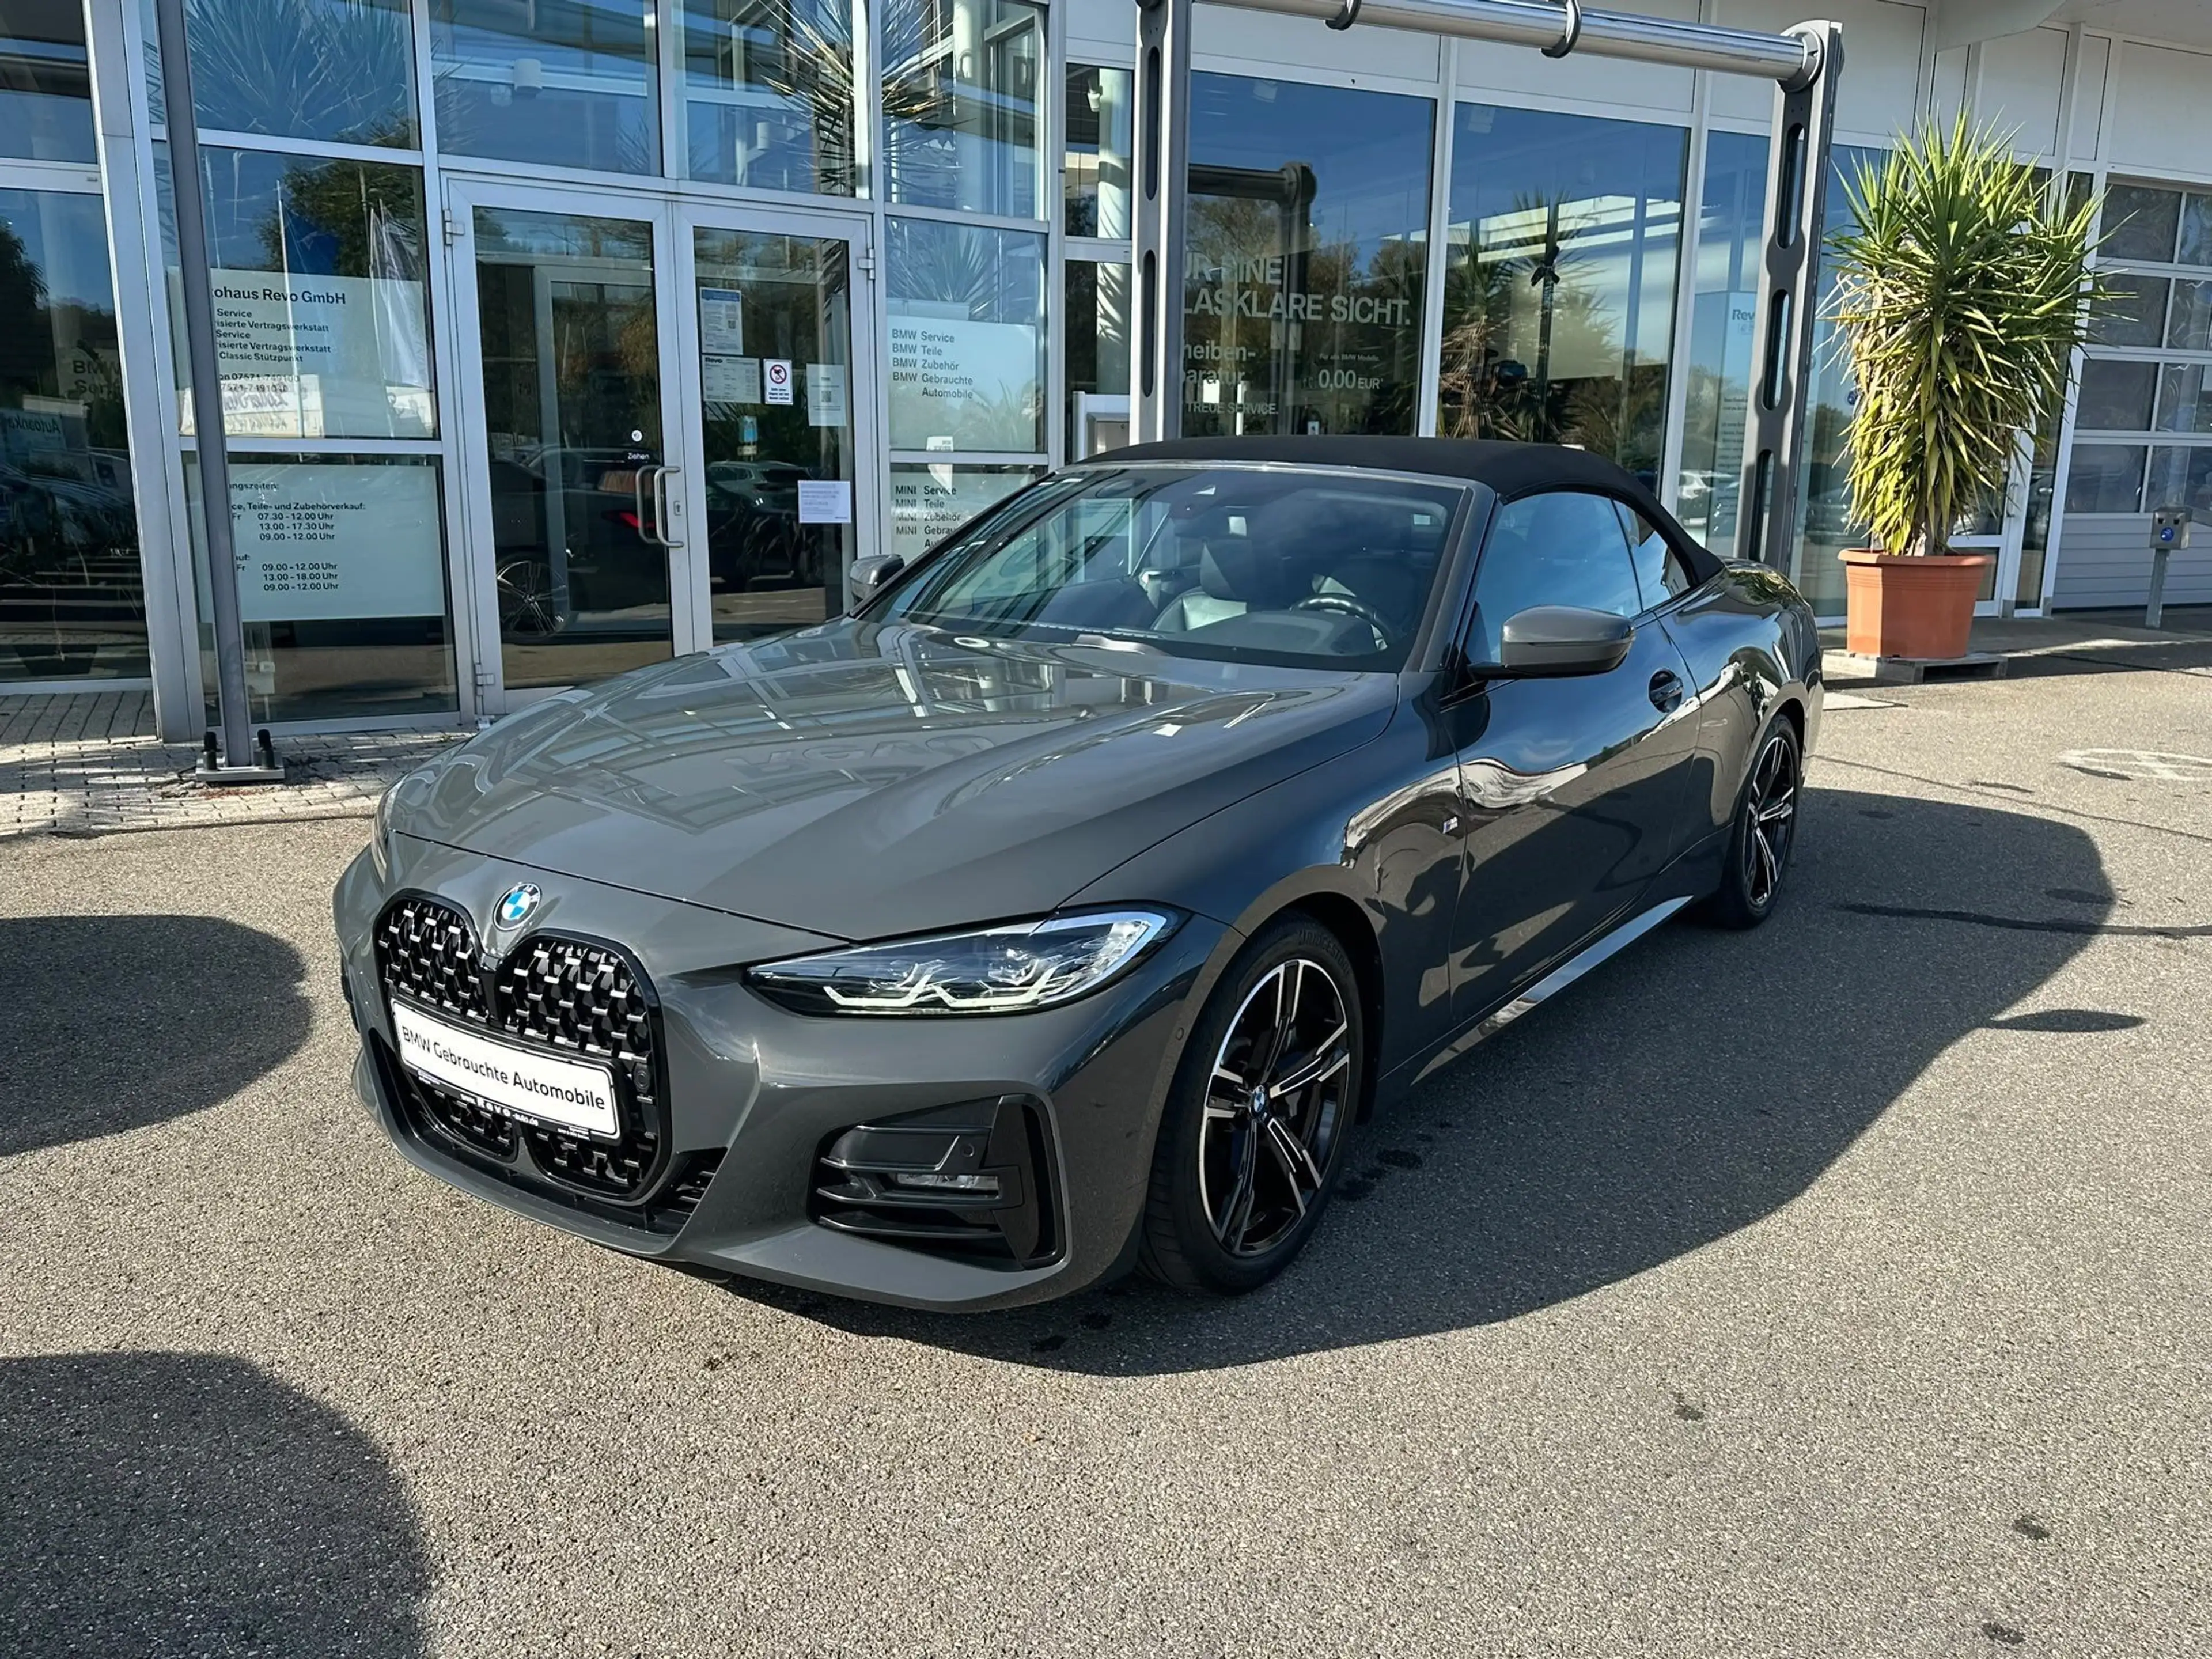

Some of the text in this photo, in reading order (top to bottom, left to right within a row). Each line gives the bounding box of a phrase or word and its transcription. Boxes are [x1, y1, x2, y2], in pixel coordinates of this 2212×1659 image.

[212, 287, 346, 304] ohaus Revo GmbH
[217, 308, 252, 317] Service
[1330, 295, 1410, 325] SICHT.
[1732, 309, 1755, 321] Rev
[216, 320, 329, 332] isierte Vertragswerkstatt
[215, 331, 251, 339] Service
[892, 328, 955, 343] BMW Service
[217, 341, 331, 353] isierte Vertragswerkstatt
[892, 343, 942, 356] BMW Teile
[219, 351, 303, 363] Classic Stützpunkt
[893, 357, 959, 370] BMW Zubehör
[893, 372, 974, 385] BMW Gebrauchte
[1186, 367, 1245, 387] aratur
[1319, 369, 1357, 392] 0,00
[922, 387, 973, 399] Automobile
[1227, 403, 1279, 414] SERVICE.
[229, 483, 279, 491] ngszeiten:
[895, 485, 957, 495] MINI Service
[231, 503, 246, 512] ce,
[247, 502, 273, 510] Teile-
[274, 502, 291, 510] und
[895, 499, 945, 508] MINI Teile
[923, 512, 961, 522] Zubehör
[896, 525, 957, 535] MINI Gebrau
[402, 1025, 431, 1053] BMW
[433, 1041, 509, 1084] Gebrauchte
[513, 1071, 605, 1110] Automobile
